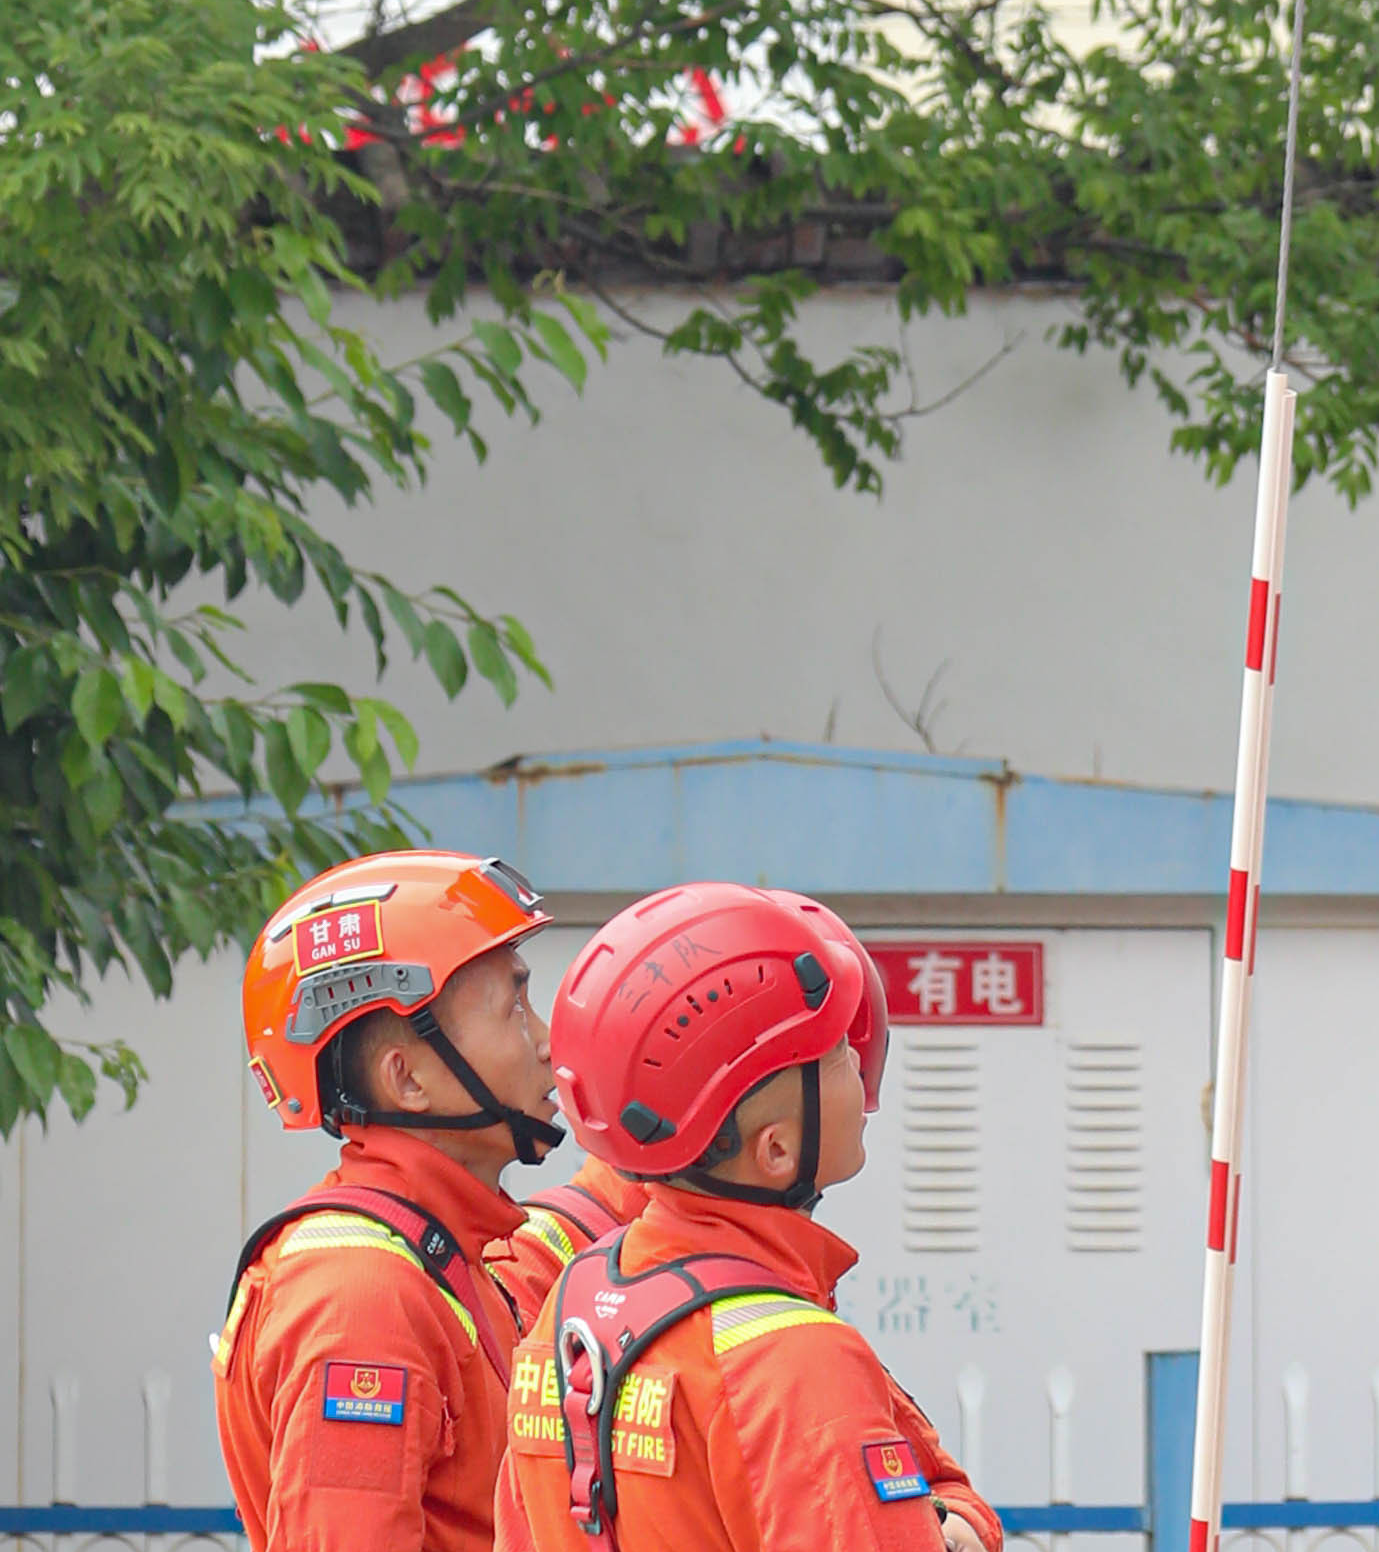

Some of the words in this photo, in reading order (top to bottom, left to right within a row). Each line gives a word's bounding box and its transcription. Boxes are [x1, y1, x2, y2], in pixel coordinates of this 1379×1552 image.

[309, 912, 361, 946] 甘肃
[311, 943, 337, 960] GAN
[343, 938, 361, 952] SU
[907, 950, 1023, 1015] 有电
[513, 1412, 565, 1441] CHINE
[627, 1432, 665, 1462] FIRE
